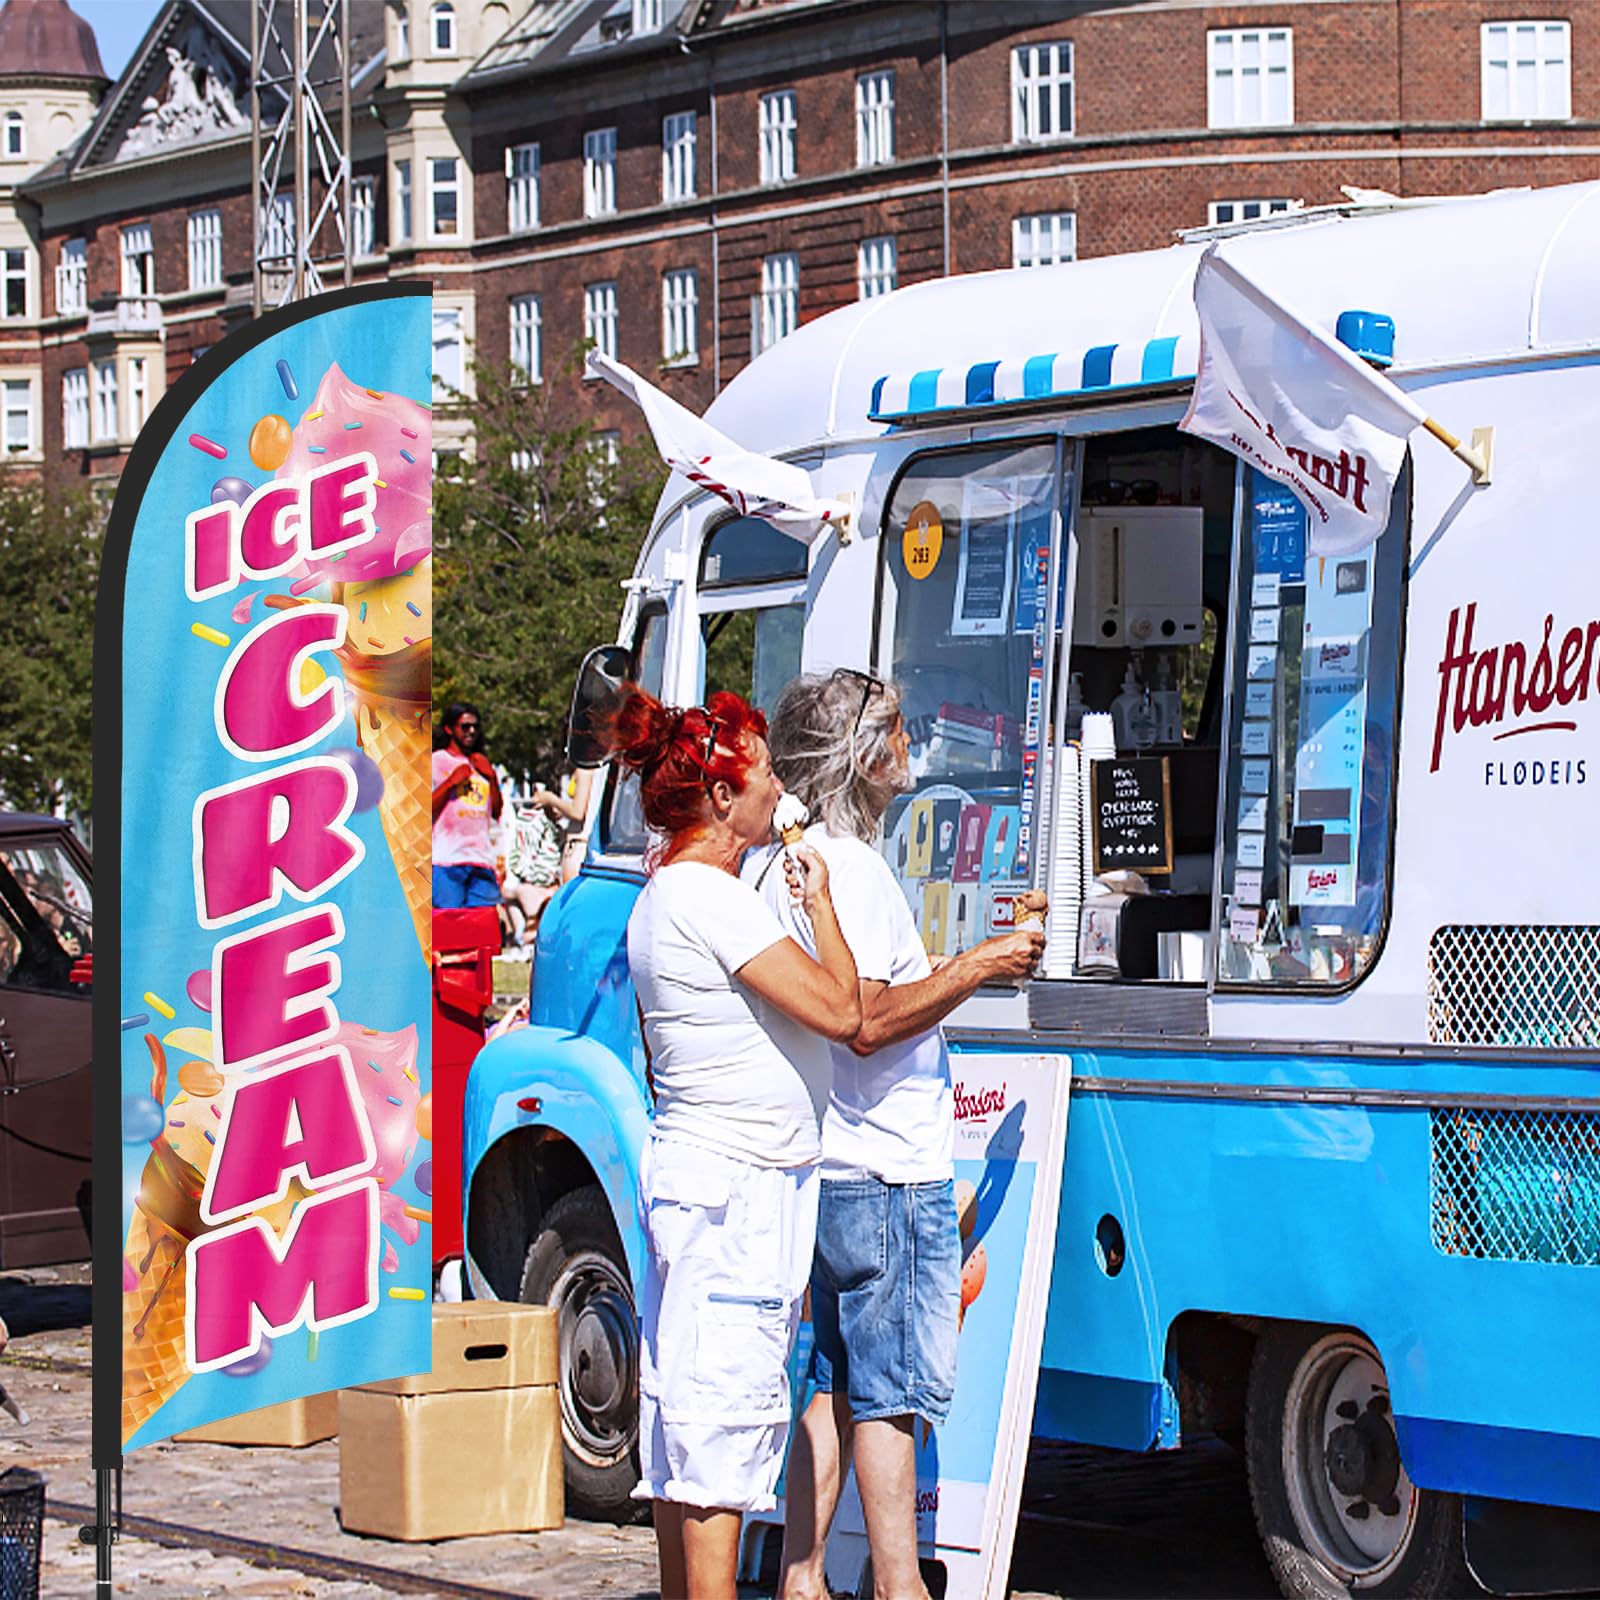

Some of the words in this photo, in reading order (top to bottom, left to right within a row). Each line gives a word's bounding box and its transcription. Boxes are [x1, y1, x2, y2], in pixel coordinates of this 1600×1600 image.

[186, 453, 377, 599] ICE
[1485, 760, 1586, 785] FLØDEIS
[186, 604, 379, 1372] CREAM
